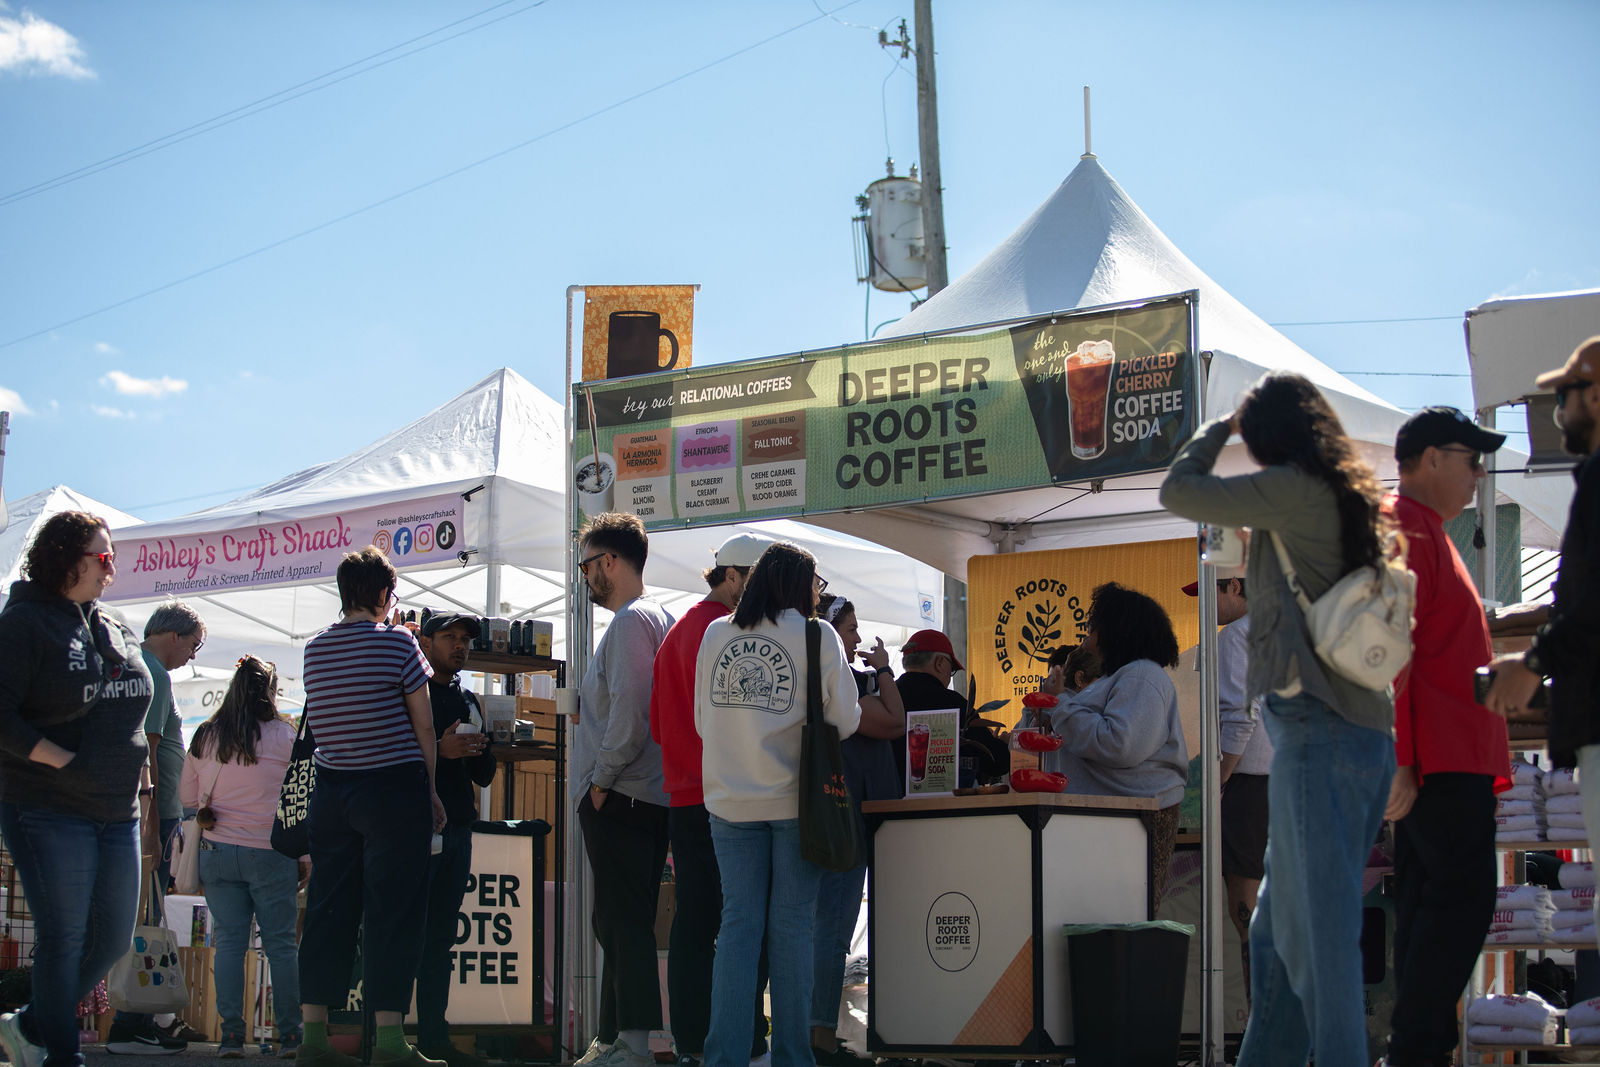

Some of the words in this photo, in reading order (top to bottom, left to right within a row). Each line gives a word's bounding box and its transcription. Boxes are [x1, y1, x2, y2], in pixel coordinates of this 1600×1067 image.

[1034, 330, 1056, 350] the
[1024, 357, 1048, 372] one
[1048, 340, 1071, 362] and
[1119, 352, 1176, 376] PICKLED
[1036, 364, 1064, 383] only
[838, 357, 990, 408] DEEPER
[1116, 370, 1173, 393] CHERRY
[622, 396, 648, 419] try
[651, 395, 676, 408] our
[680, 383, 744, 404] RELATIONAL
[746, 376, 792, 396] COFFEES
[1114, 390, 1182, 418] COFFEE
[752, 418, 778, 428] SEASONAL
[779, 416, 796, 424] BLEND
[847, 398, 977, 448] ROOTS
[696, 426, 718, 435] ETHIOPIA
[1112, 417, 1162, 443] SODA
[630, 434, 657, 444] GUATEMALA
[754, 438, 770, 449] FALL
[770, 436, 792, 447] TONIC
[622, 452, 632, 460] LA
[633, 449, 662, 460] ARMONIA
[684, 444, 729, 458] SHANTAWENE
[626, 458, 658, 468] HERMOSA
[836, 439, 988, 490] COFFEE
[750, 470, 768, 480] CREME
[770, 468, 796, 478] CARAMEL
[690, 476, 724, 487] BLACKBERRY
[754, 481, 774, 490] SPICED
[776, 479, 792, 488] CIDER
[632, 484, 652, 494] CHERRY
[697, 488, 718, 497] CREAMY
[752, 491, 772, 501] BLOOD
[774, 489, 798, 499] ORANGE
[632, 496, 655, 506] ALMOND
[686, 500, 704, 508] BLACK
[705, 497, 730, 507] CURRANT
[377, 518, 396, 526] Follow
[398, 508, 456, 525] @ashleyscraftshack
[636, 508, 655, 516] RAISIN
[132, 538, 216, 579] Ashley's
[222, 528, 279, 571] Craft
[282, 516, 352, 555] Shack
[154, 576, 210, 592] Embroidered
[210, 575, 218, 586] &
[220, 572, 250, 585] Screen
[251, 566, 284, 581] Printed
[286, 562, 322, 578] Apparel
[994, 600, 1016, 674] DEEPER
[1015, 578, 1068, 600] ROOTS
[720, 641, 790, 694] MEMORIAL
[1012, 674, 1040, 684] GOOD
[83, 677, 152, 703] CHMPIONS
[1014, 686, 1028, 696] THE
[930, 738, 954, 746] PICKLED
[930, 746, 952, 754] CHERRY
[929, 754, 954, 764] COFFEE
[928, 766, 946, 774] SODA
[296, 759, 310, 821] ROOTS
[936, 916, 970, 925] DEEPER
[938, 926, 968, 934] ROOTS
[935, 936, 970, 944] COFFEE
